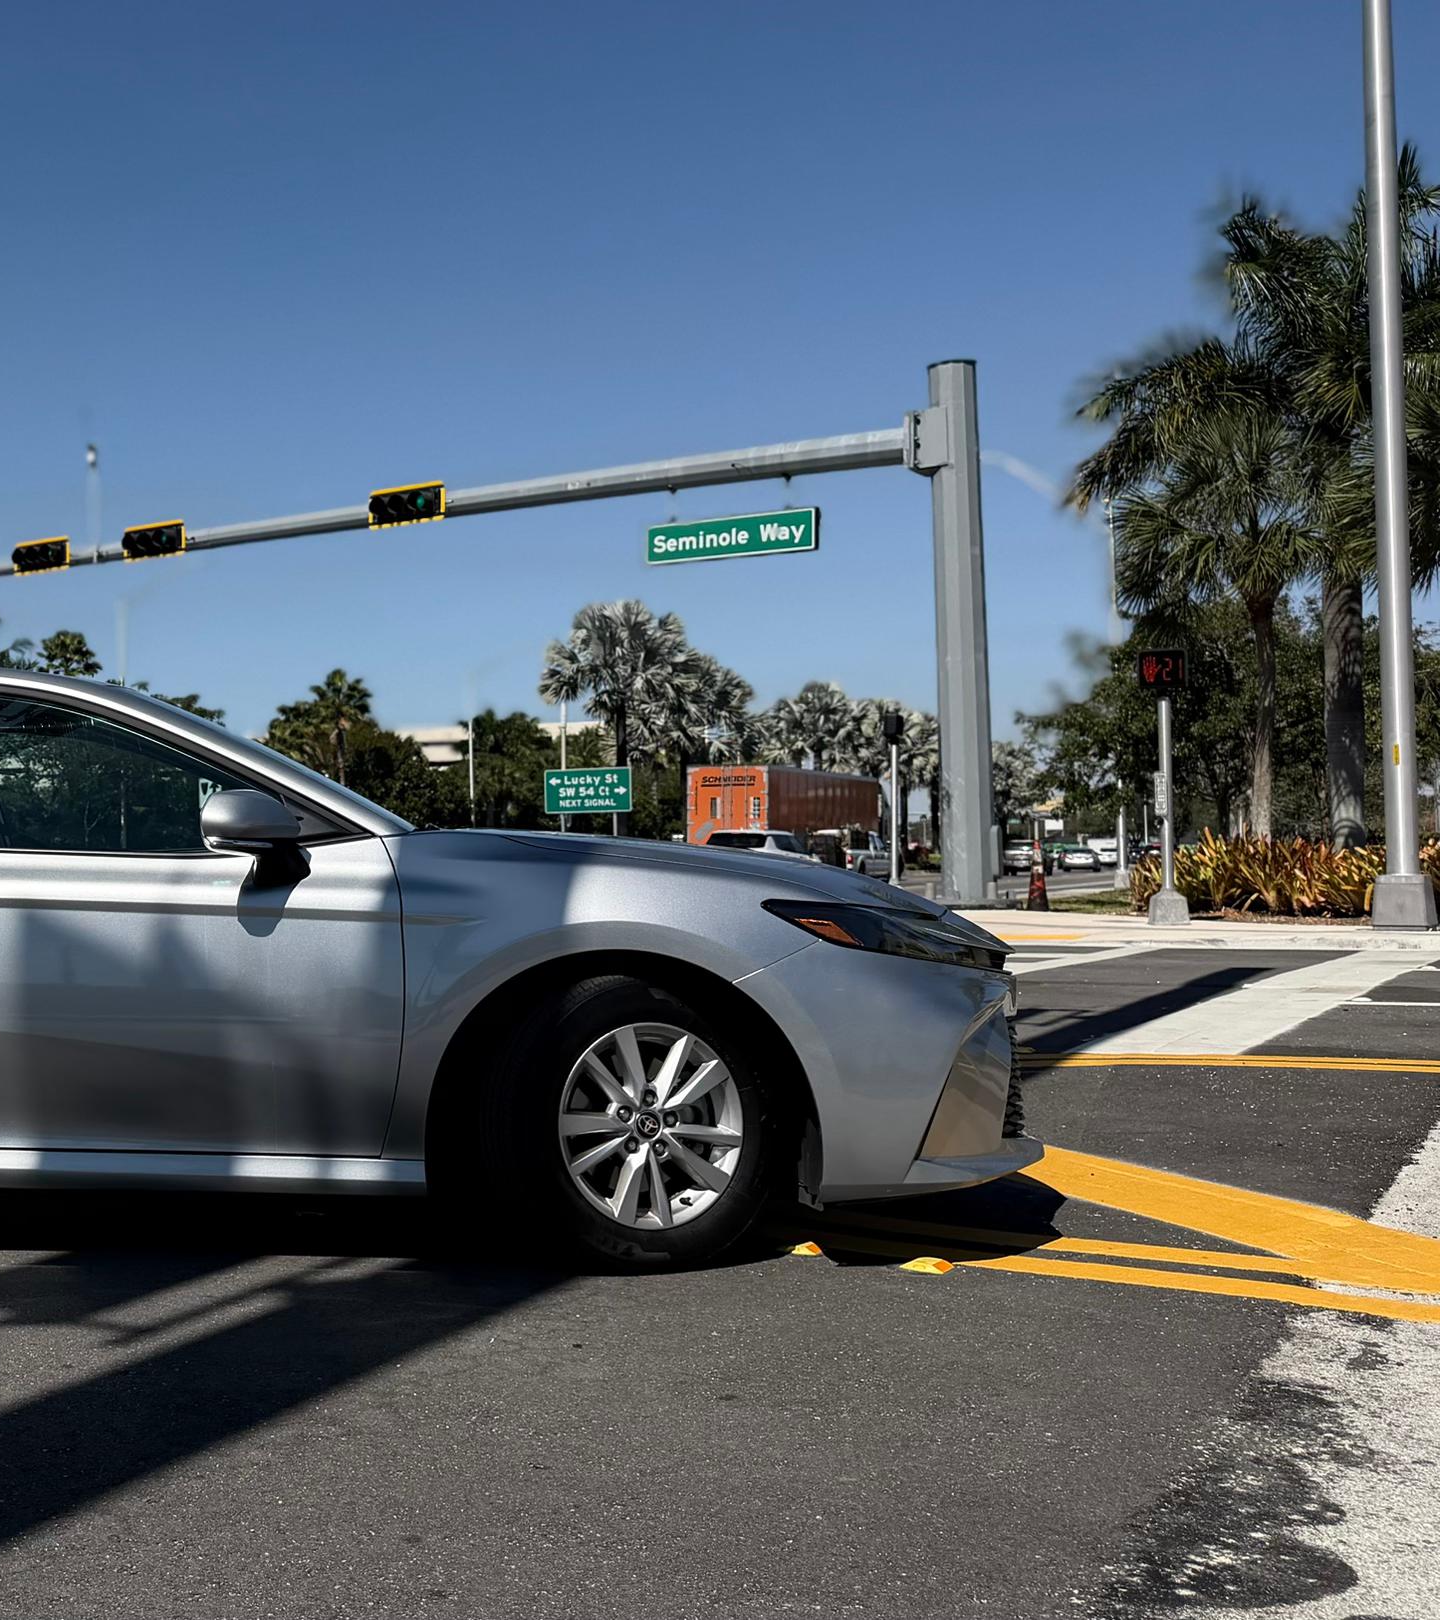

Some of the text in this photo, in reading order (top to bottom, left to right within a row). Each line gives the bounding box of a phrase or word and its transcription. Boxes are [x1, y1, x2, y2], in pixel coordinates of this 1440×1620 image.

[652, 522, 806, 553] Seminole Way
[1162, 657, 1183, 681] 21
[564, 773, 619, 786] Lucky St
[559, 786, 610, 798] SW 54 Ct
[559, 798, 617, 808] NEXT SIGNAL
